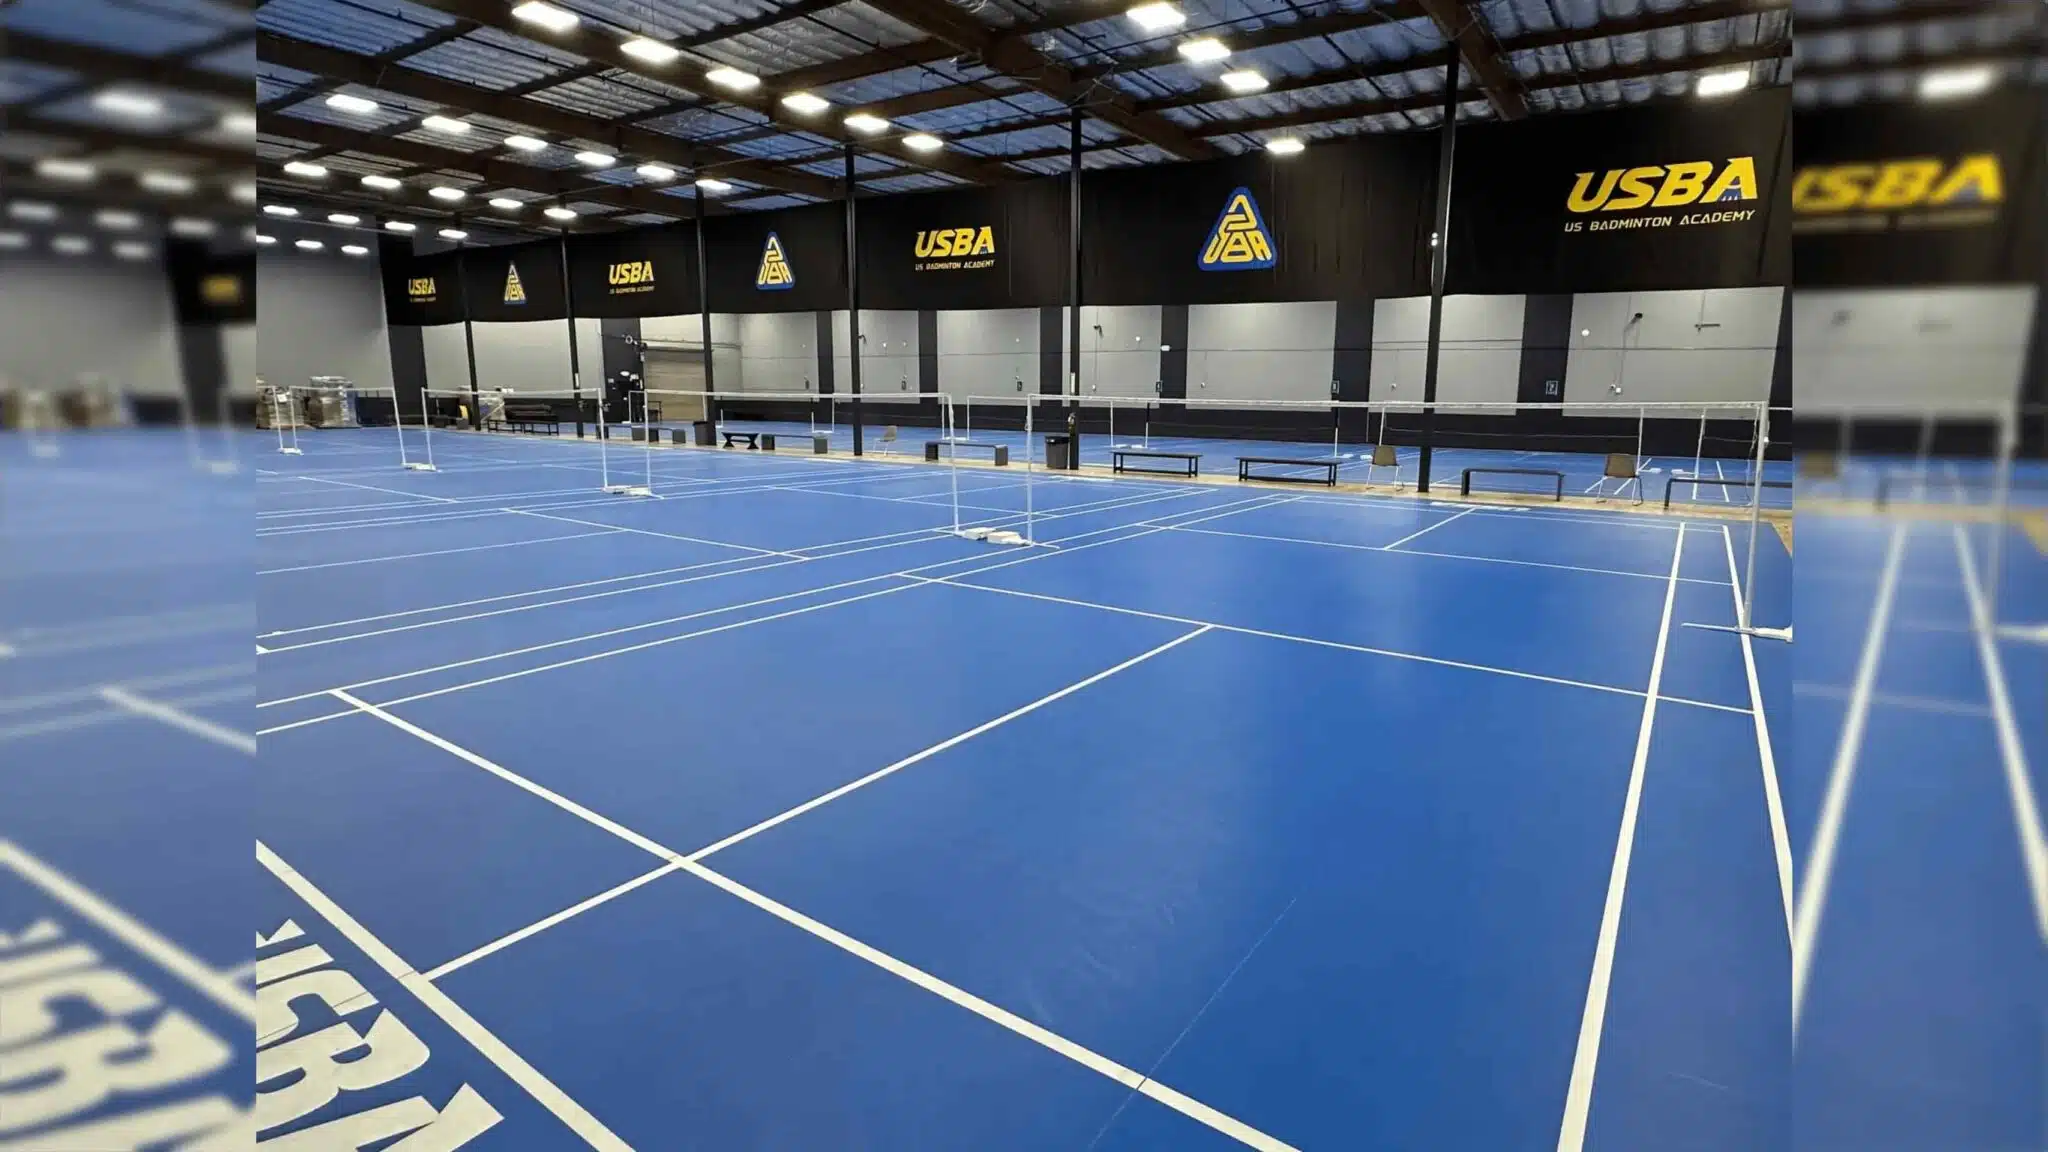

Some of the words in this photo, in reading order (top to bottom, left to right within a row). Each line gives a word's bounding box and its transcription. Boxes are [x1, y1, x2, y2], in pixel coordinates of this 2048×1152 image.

[1566, 156, 1758, 213] USBA
[1564, 222, 1583, 233] US
[1589, 216, 1674, 232] BADMINTON
[1679, 209, 1756, 226] ACADEMY
[915, 226, 995, 258] USBA
[608, 260, 655, 285] USBA
[915, 263, 924, 271] US
[926, 261, 961, 270] BADMINTON
[963, 259, 995, 269] ACADEMY
[408, 274, 437, 295] USBA
